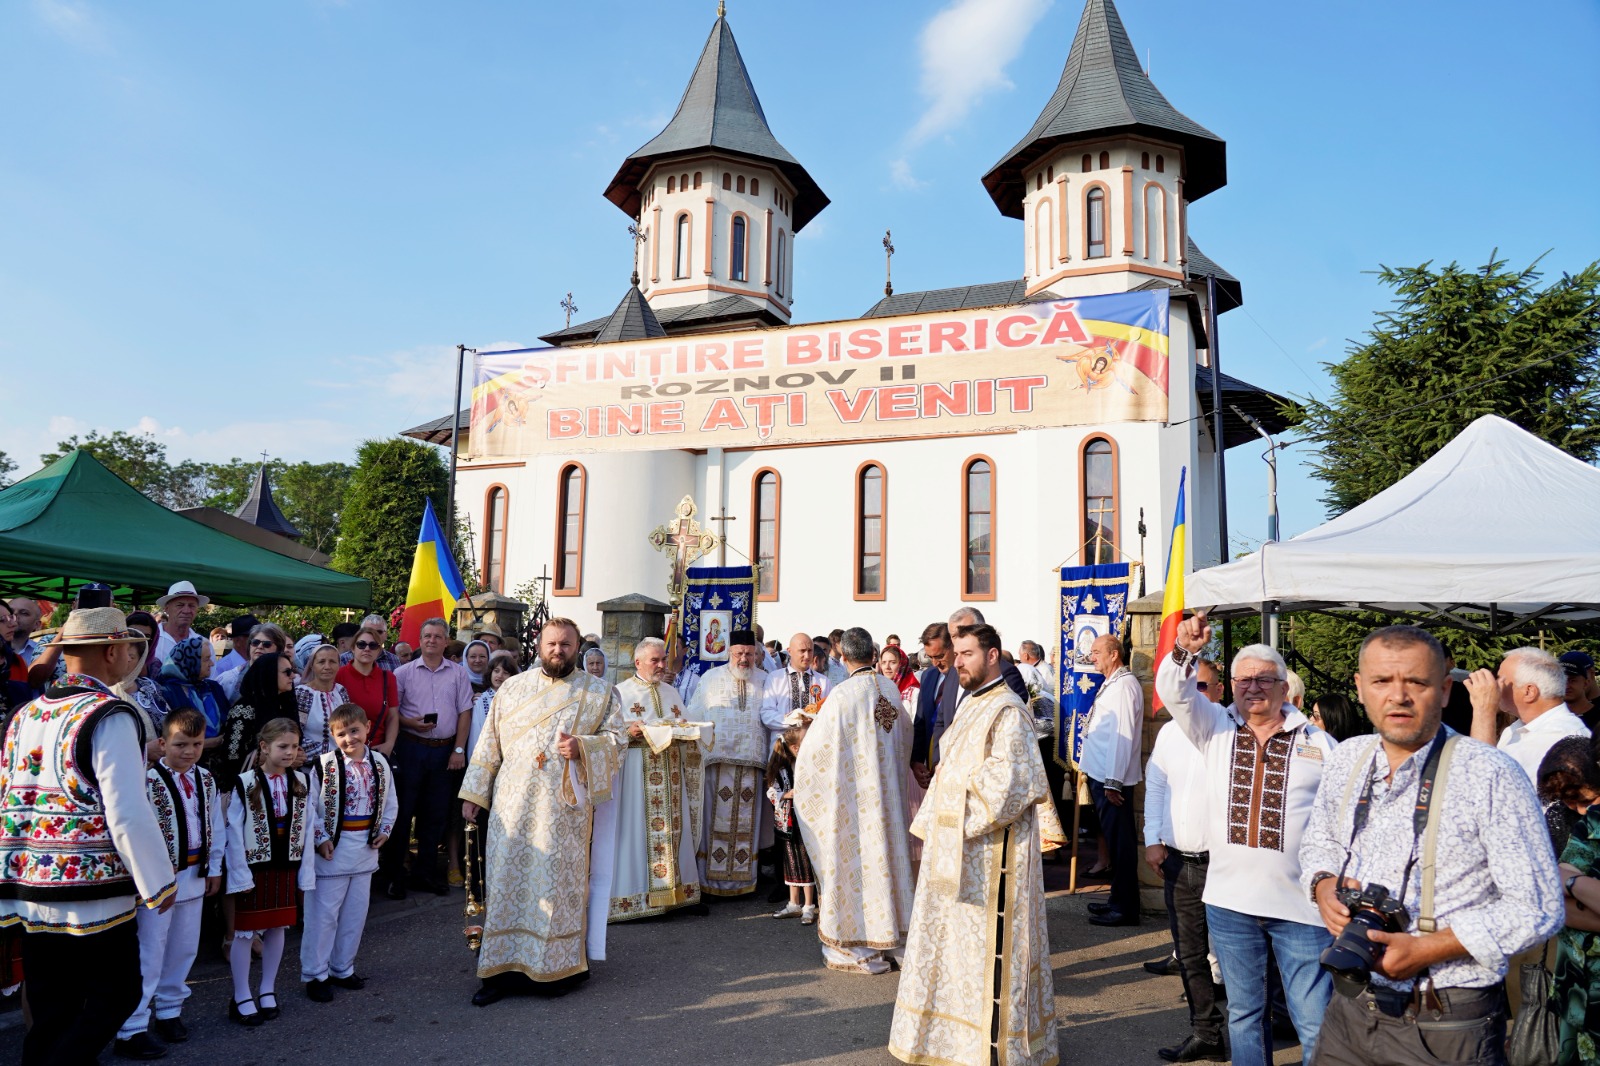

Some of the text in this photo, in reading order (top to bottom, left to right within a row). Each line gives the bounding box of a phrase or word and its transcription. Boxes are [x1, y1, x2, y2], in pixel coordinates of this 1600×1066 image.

[522, 303, 1092, 387] SFINȚIRE BISERICĂ
[547, 374, 1047, 440] BINE AȚI VENIT
[620, 364, 916, 400] ROZNOV II
